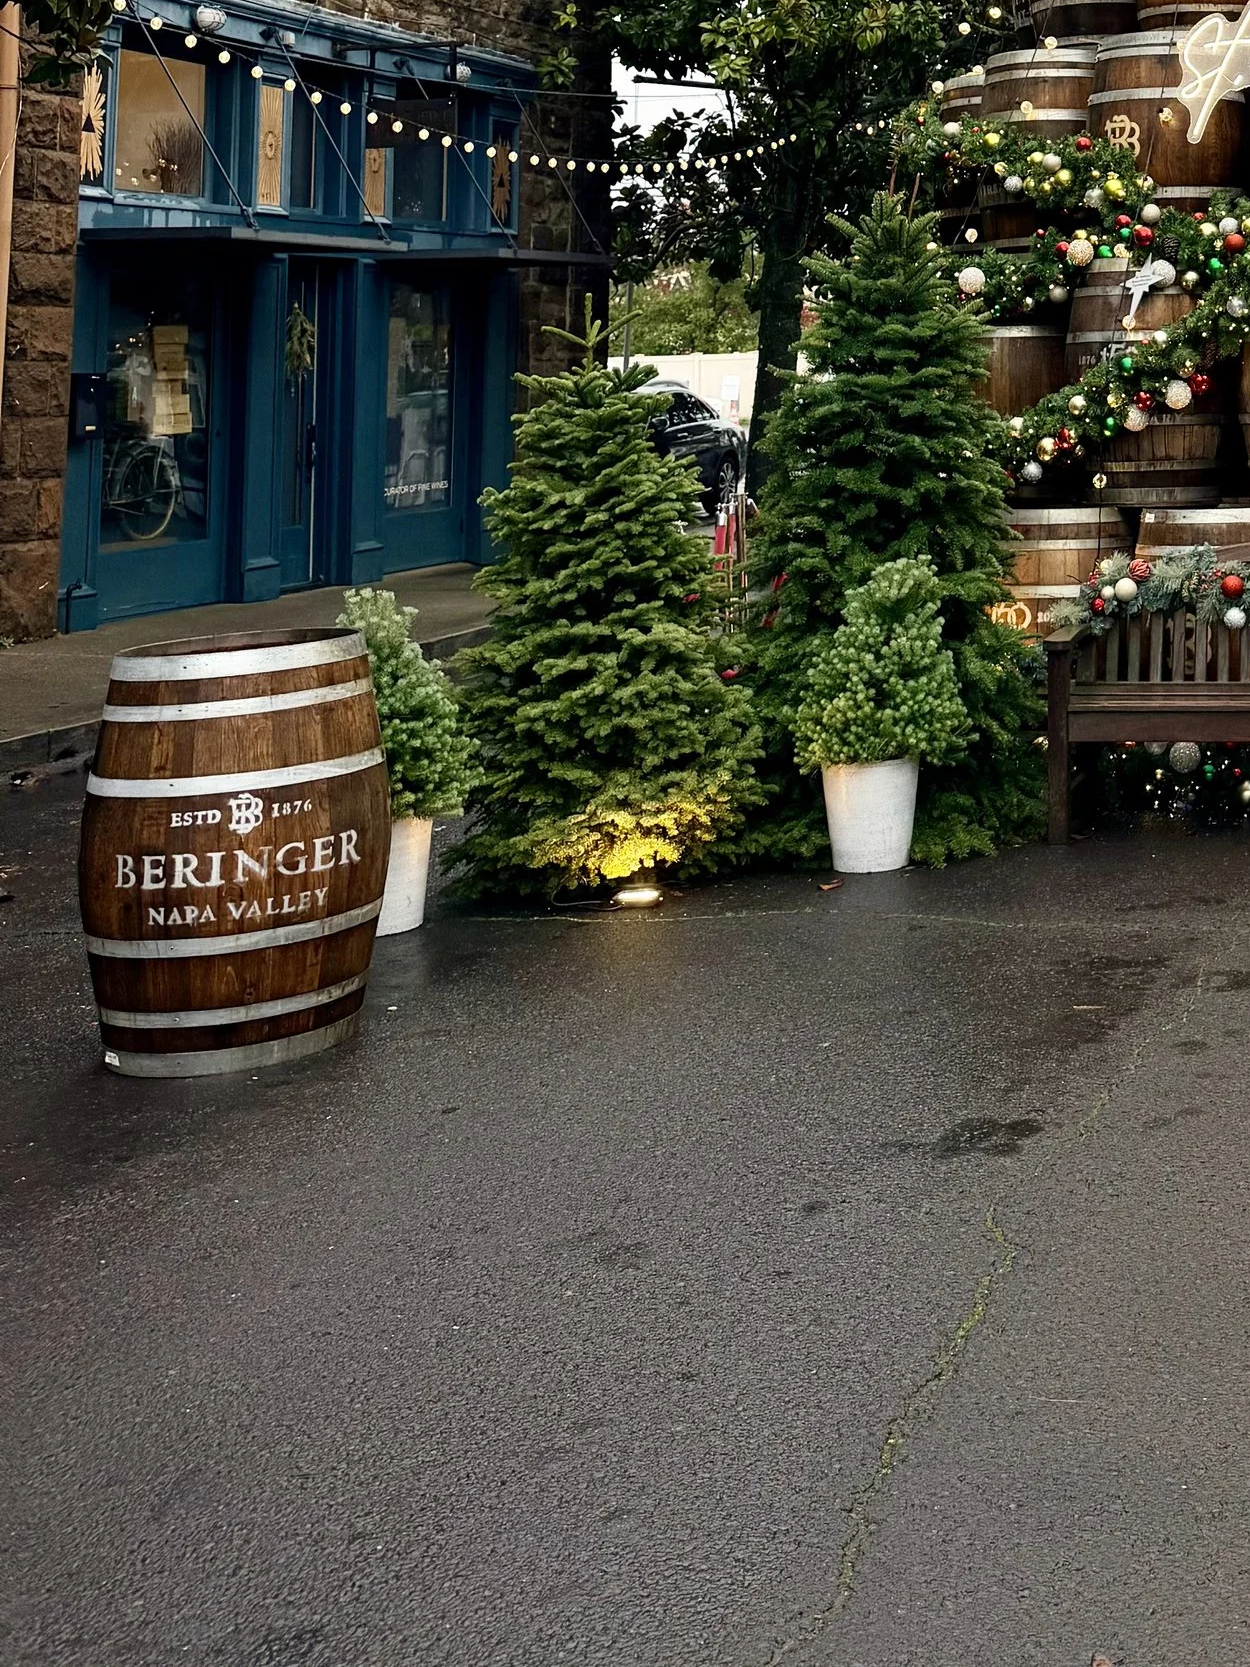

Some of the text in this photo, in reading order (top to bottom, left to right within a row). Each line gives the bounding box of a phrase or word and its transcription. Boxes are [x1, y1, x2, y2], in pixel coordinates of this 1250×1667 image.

[383, 480, 449, 497] CURATOR OF FINE WINES
[1036, 611, 1051, 624] 20
[170, 809, 222, 828] ESTD
[272, 798, 313, 819] 1876
[114, 829, 362, 890] BERINGER
[148, 886, 330, 926] NAPA VALLEY
